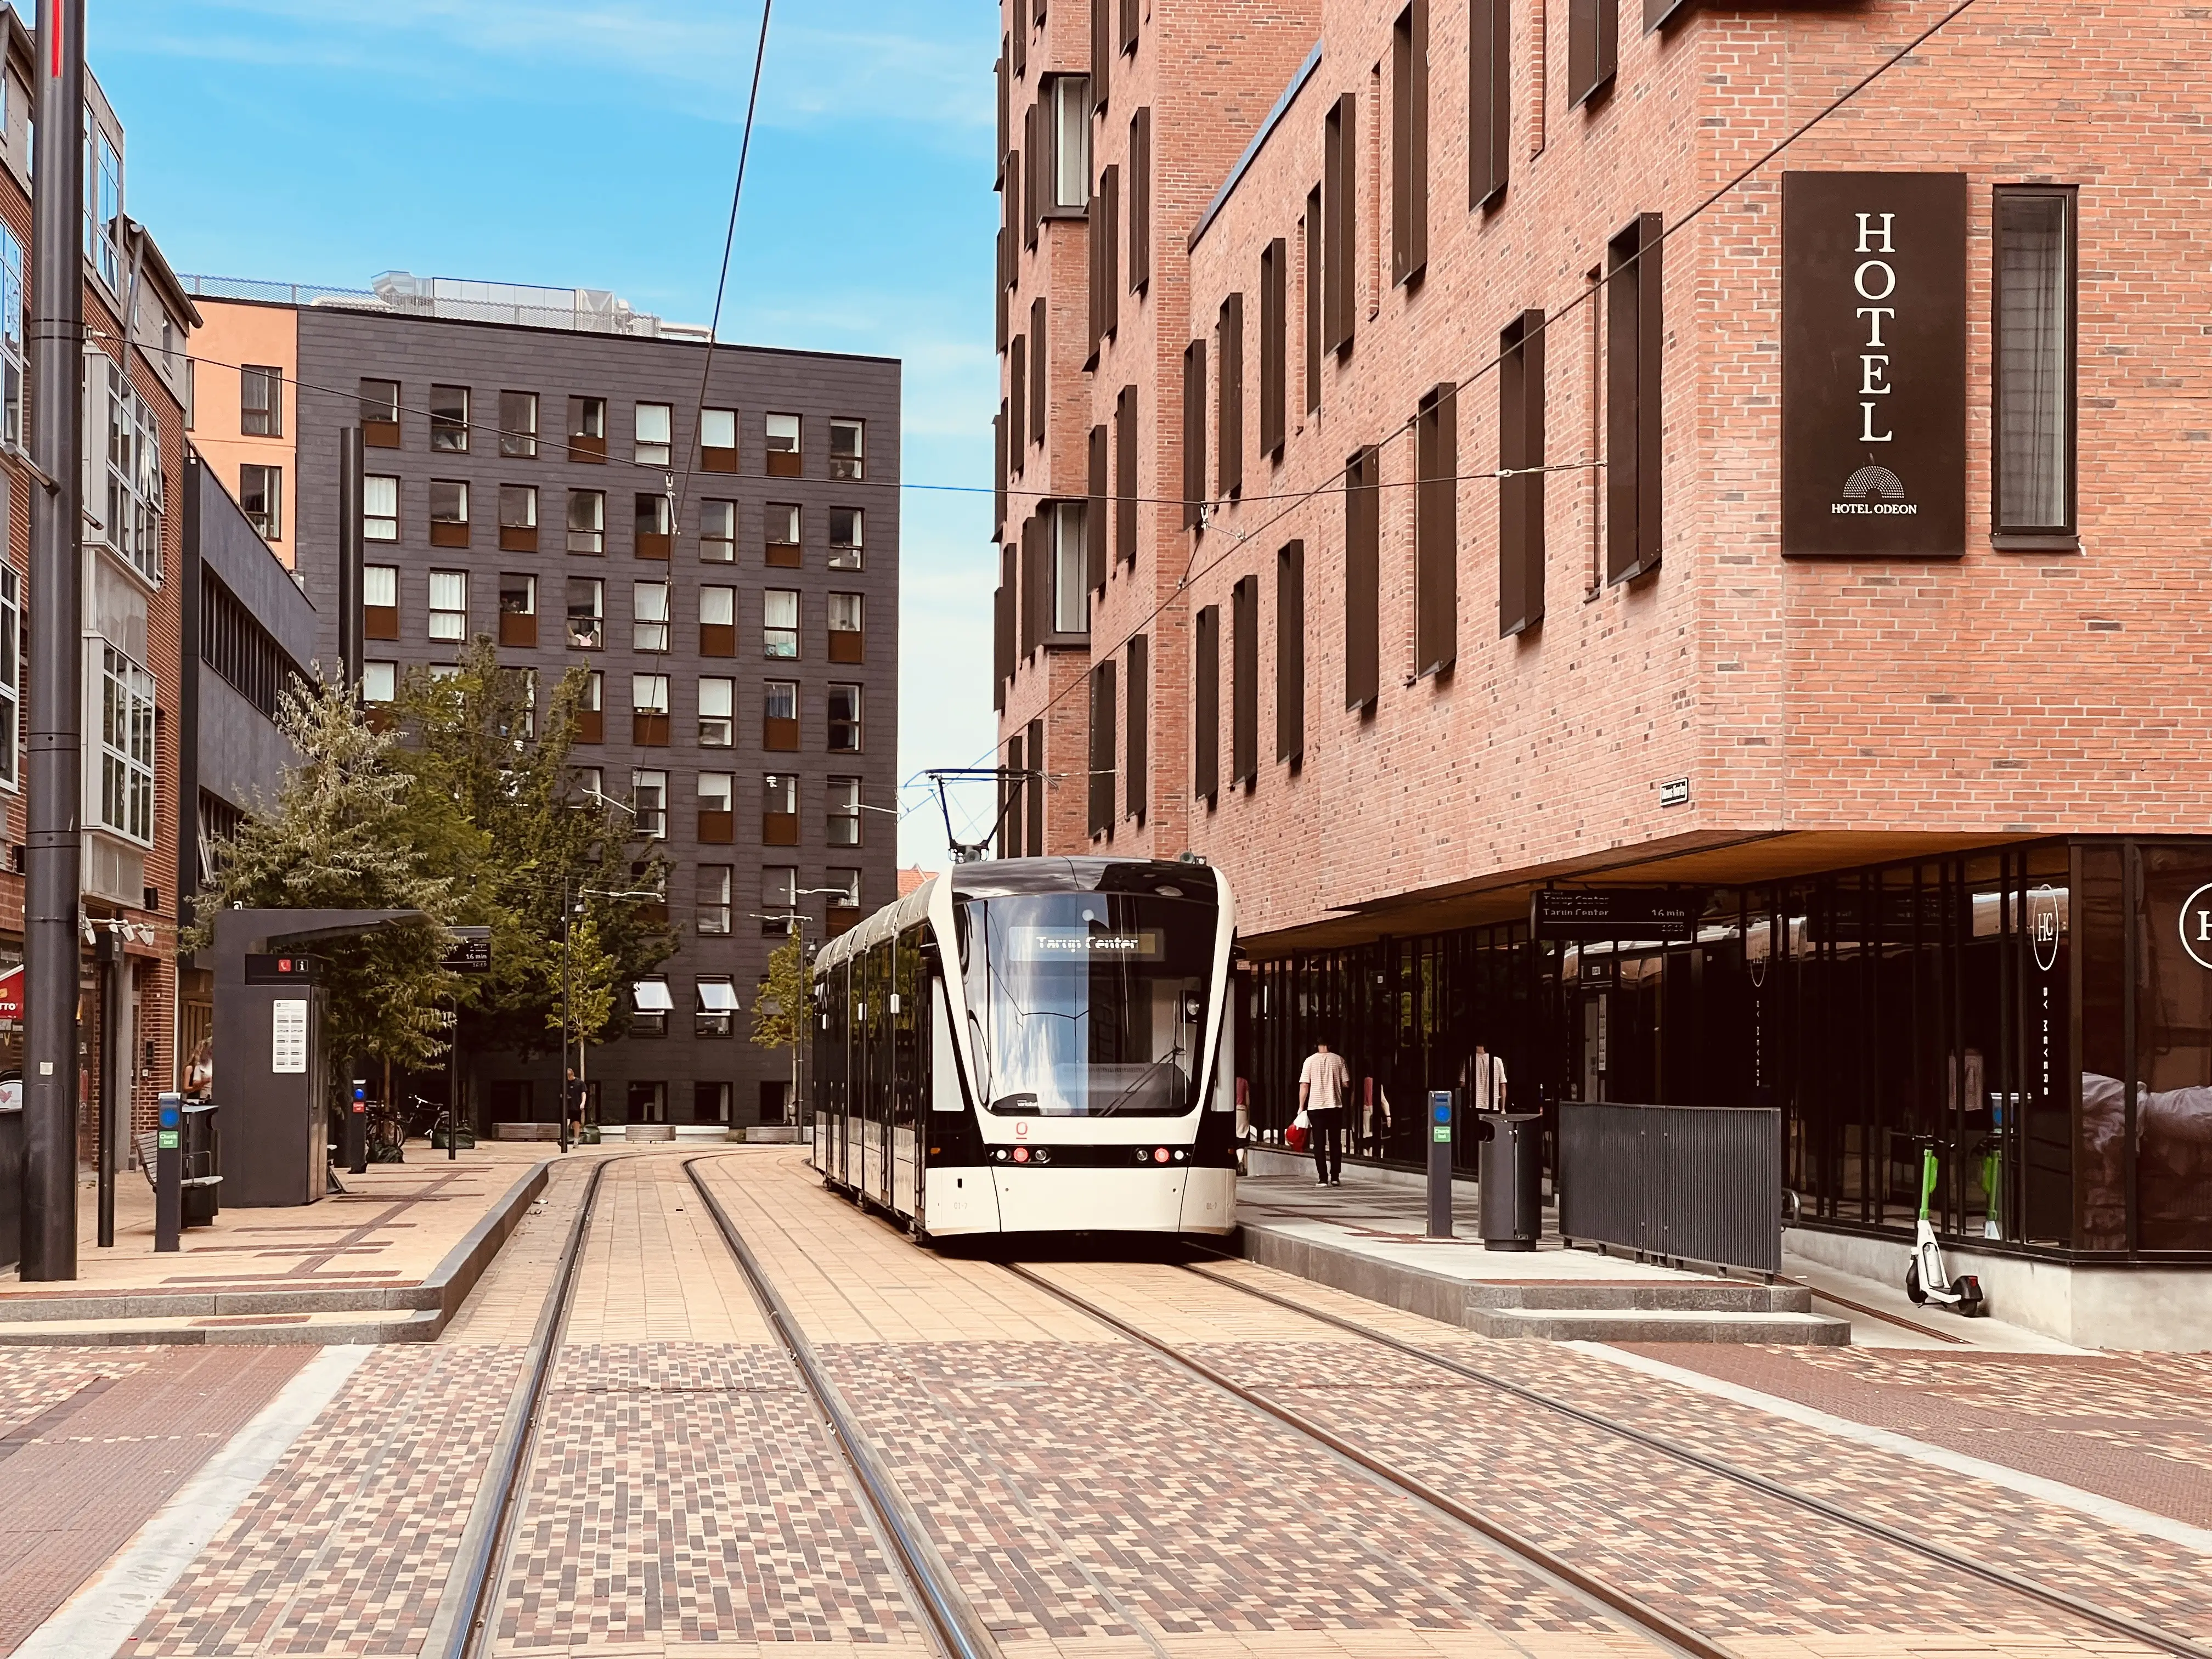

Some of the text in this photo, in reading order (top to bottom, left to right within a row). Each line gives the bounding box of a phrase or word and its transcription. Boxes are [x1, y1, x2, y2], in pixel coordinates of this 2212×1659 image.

[1854, 213, 1896, 442] HOTEL
[1831, 504, 1917, 514] HOTEL ODEON
